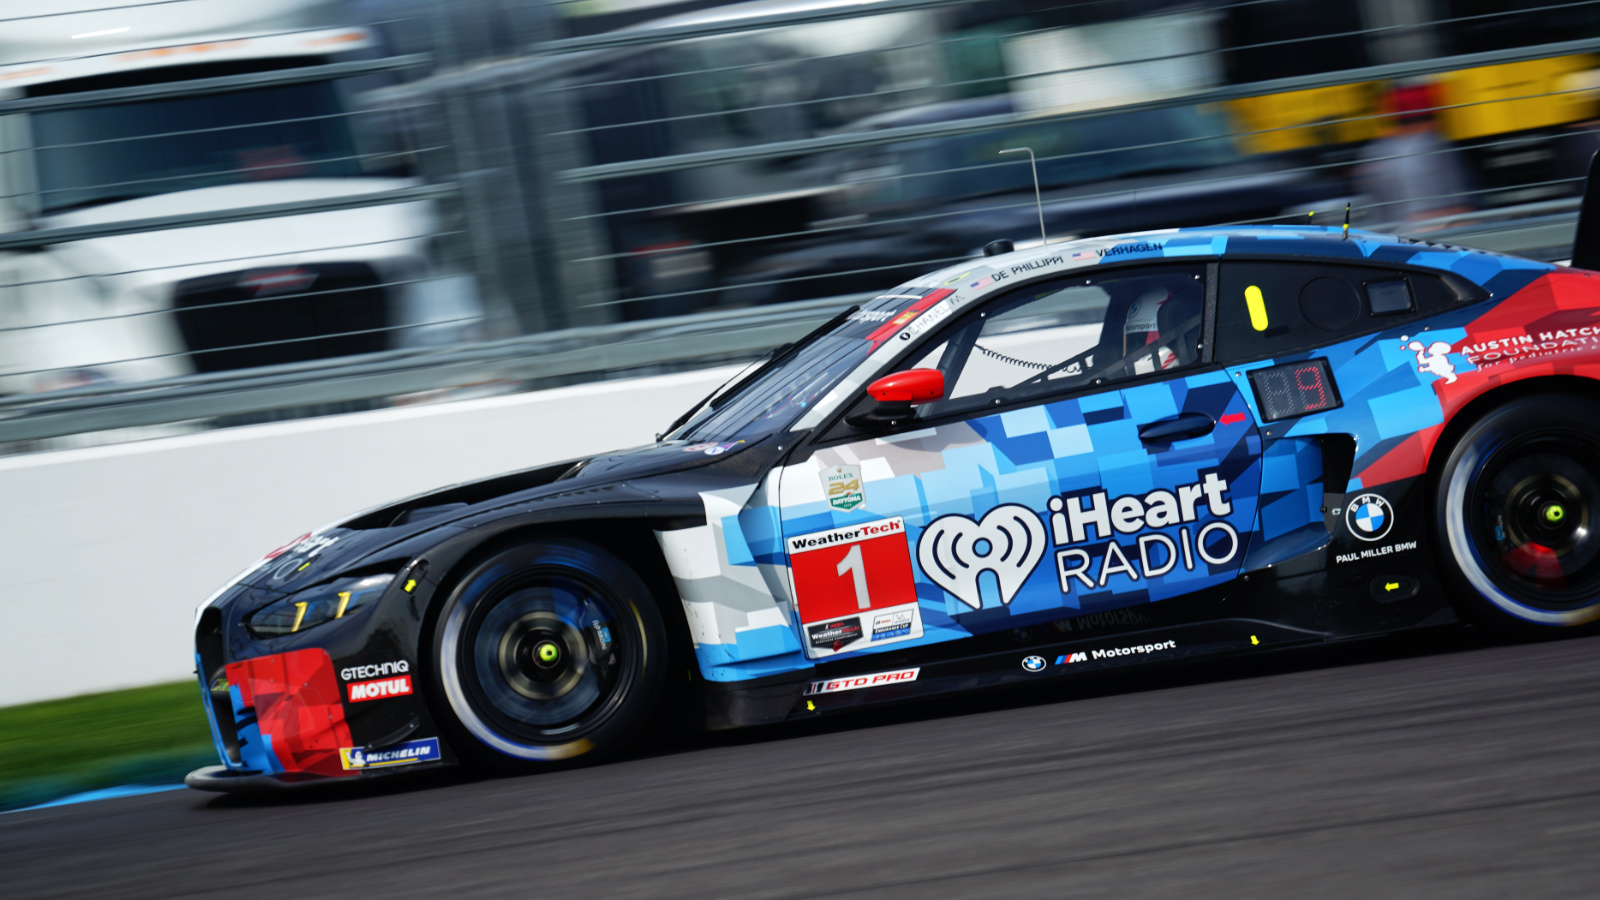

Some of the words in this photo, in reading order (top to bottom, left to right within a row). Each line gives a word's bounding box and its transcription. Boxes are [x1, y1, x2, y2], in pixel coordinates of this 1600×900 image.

[1095, 243, 1163, 257] VERHAGEN
[991, 269, 1009, 282] DE
[1011, 255, 1064, 276] PHILLIPPI
[1461, 334, 1534, 356] AUSTIN
[1467, 336, 1599, 365] FOUNDATI
[1477, 360, 1501, 373] for
[1294, 366, 1327, 410] 9
[828, 472, 854, 482] ROLEX
[828, 478, 860, 496] 24
[1050, 472, 1232, 545] iHeart
[1056, 521, 1239, 594] RADIO
[1336, 552, 1360, 563] PAUL
[1360, 546, 1393, 559] MILLER
[1394, 541, 1417, 552] BMW
[836, 544, 871, 610] 1
[1068, 652, 1088, 663] M
[1091, 639, 1176, 660] Motorsport
[340, 659, 409, 681] GTECHNIQ
[826, 677, 868, 690] GTD
[872, 670, 915, 684] PRO
[350, 678, 410, 700] MOTUL
[366, 745, 432, 763] MICHELIN
